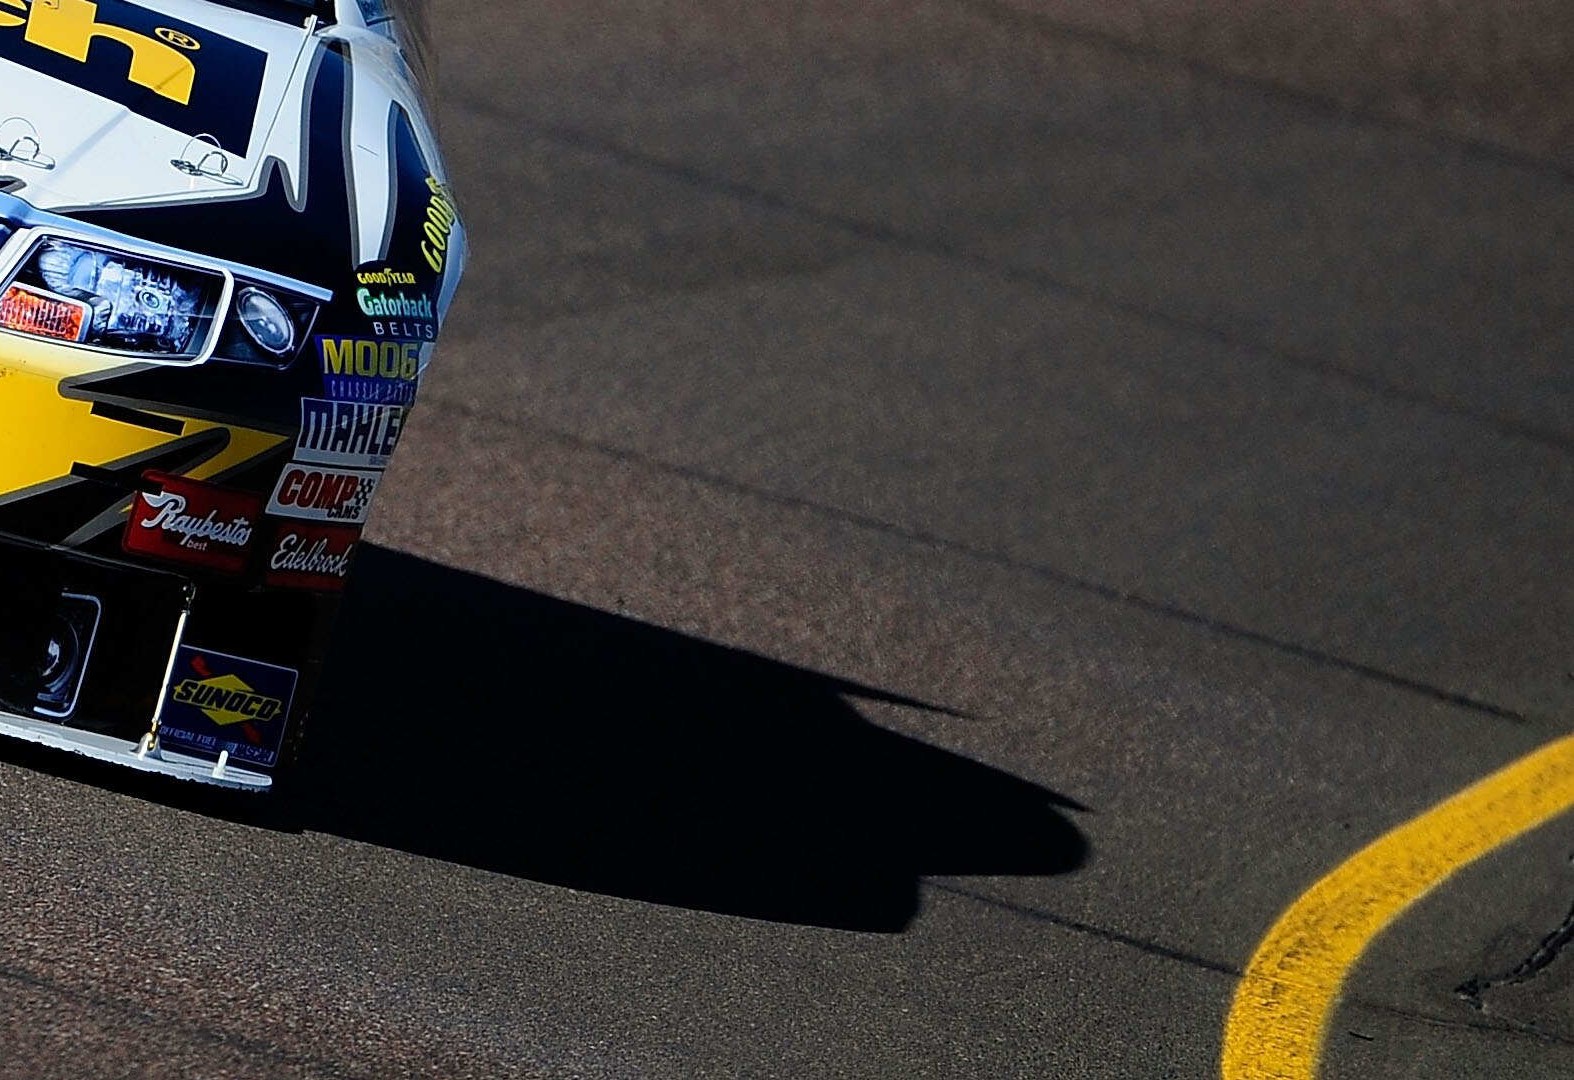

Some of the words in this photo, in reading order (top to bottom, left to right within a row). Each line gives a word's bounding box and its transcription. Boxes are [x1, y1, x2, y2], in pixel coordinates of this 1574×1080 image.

[356, 287, 432, 318] Gatorback
[373, 321, 433, 339] BELTS
[321, 338, 419, 381] MOOG
[298, 398, 401, 456] MAHLE
[276, 469, 360, 510] COMP
[140, 490, 253, 547] Raybestos
[326, 505, 361, 520] CAMS
[186, 539, 208, 552] best
[270, 533, 354, 577] Edelbrock
[176, 680, 278, 720] SUNOCO
[196, 731, 218, 747] FUEL
